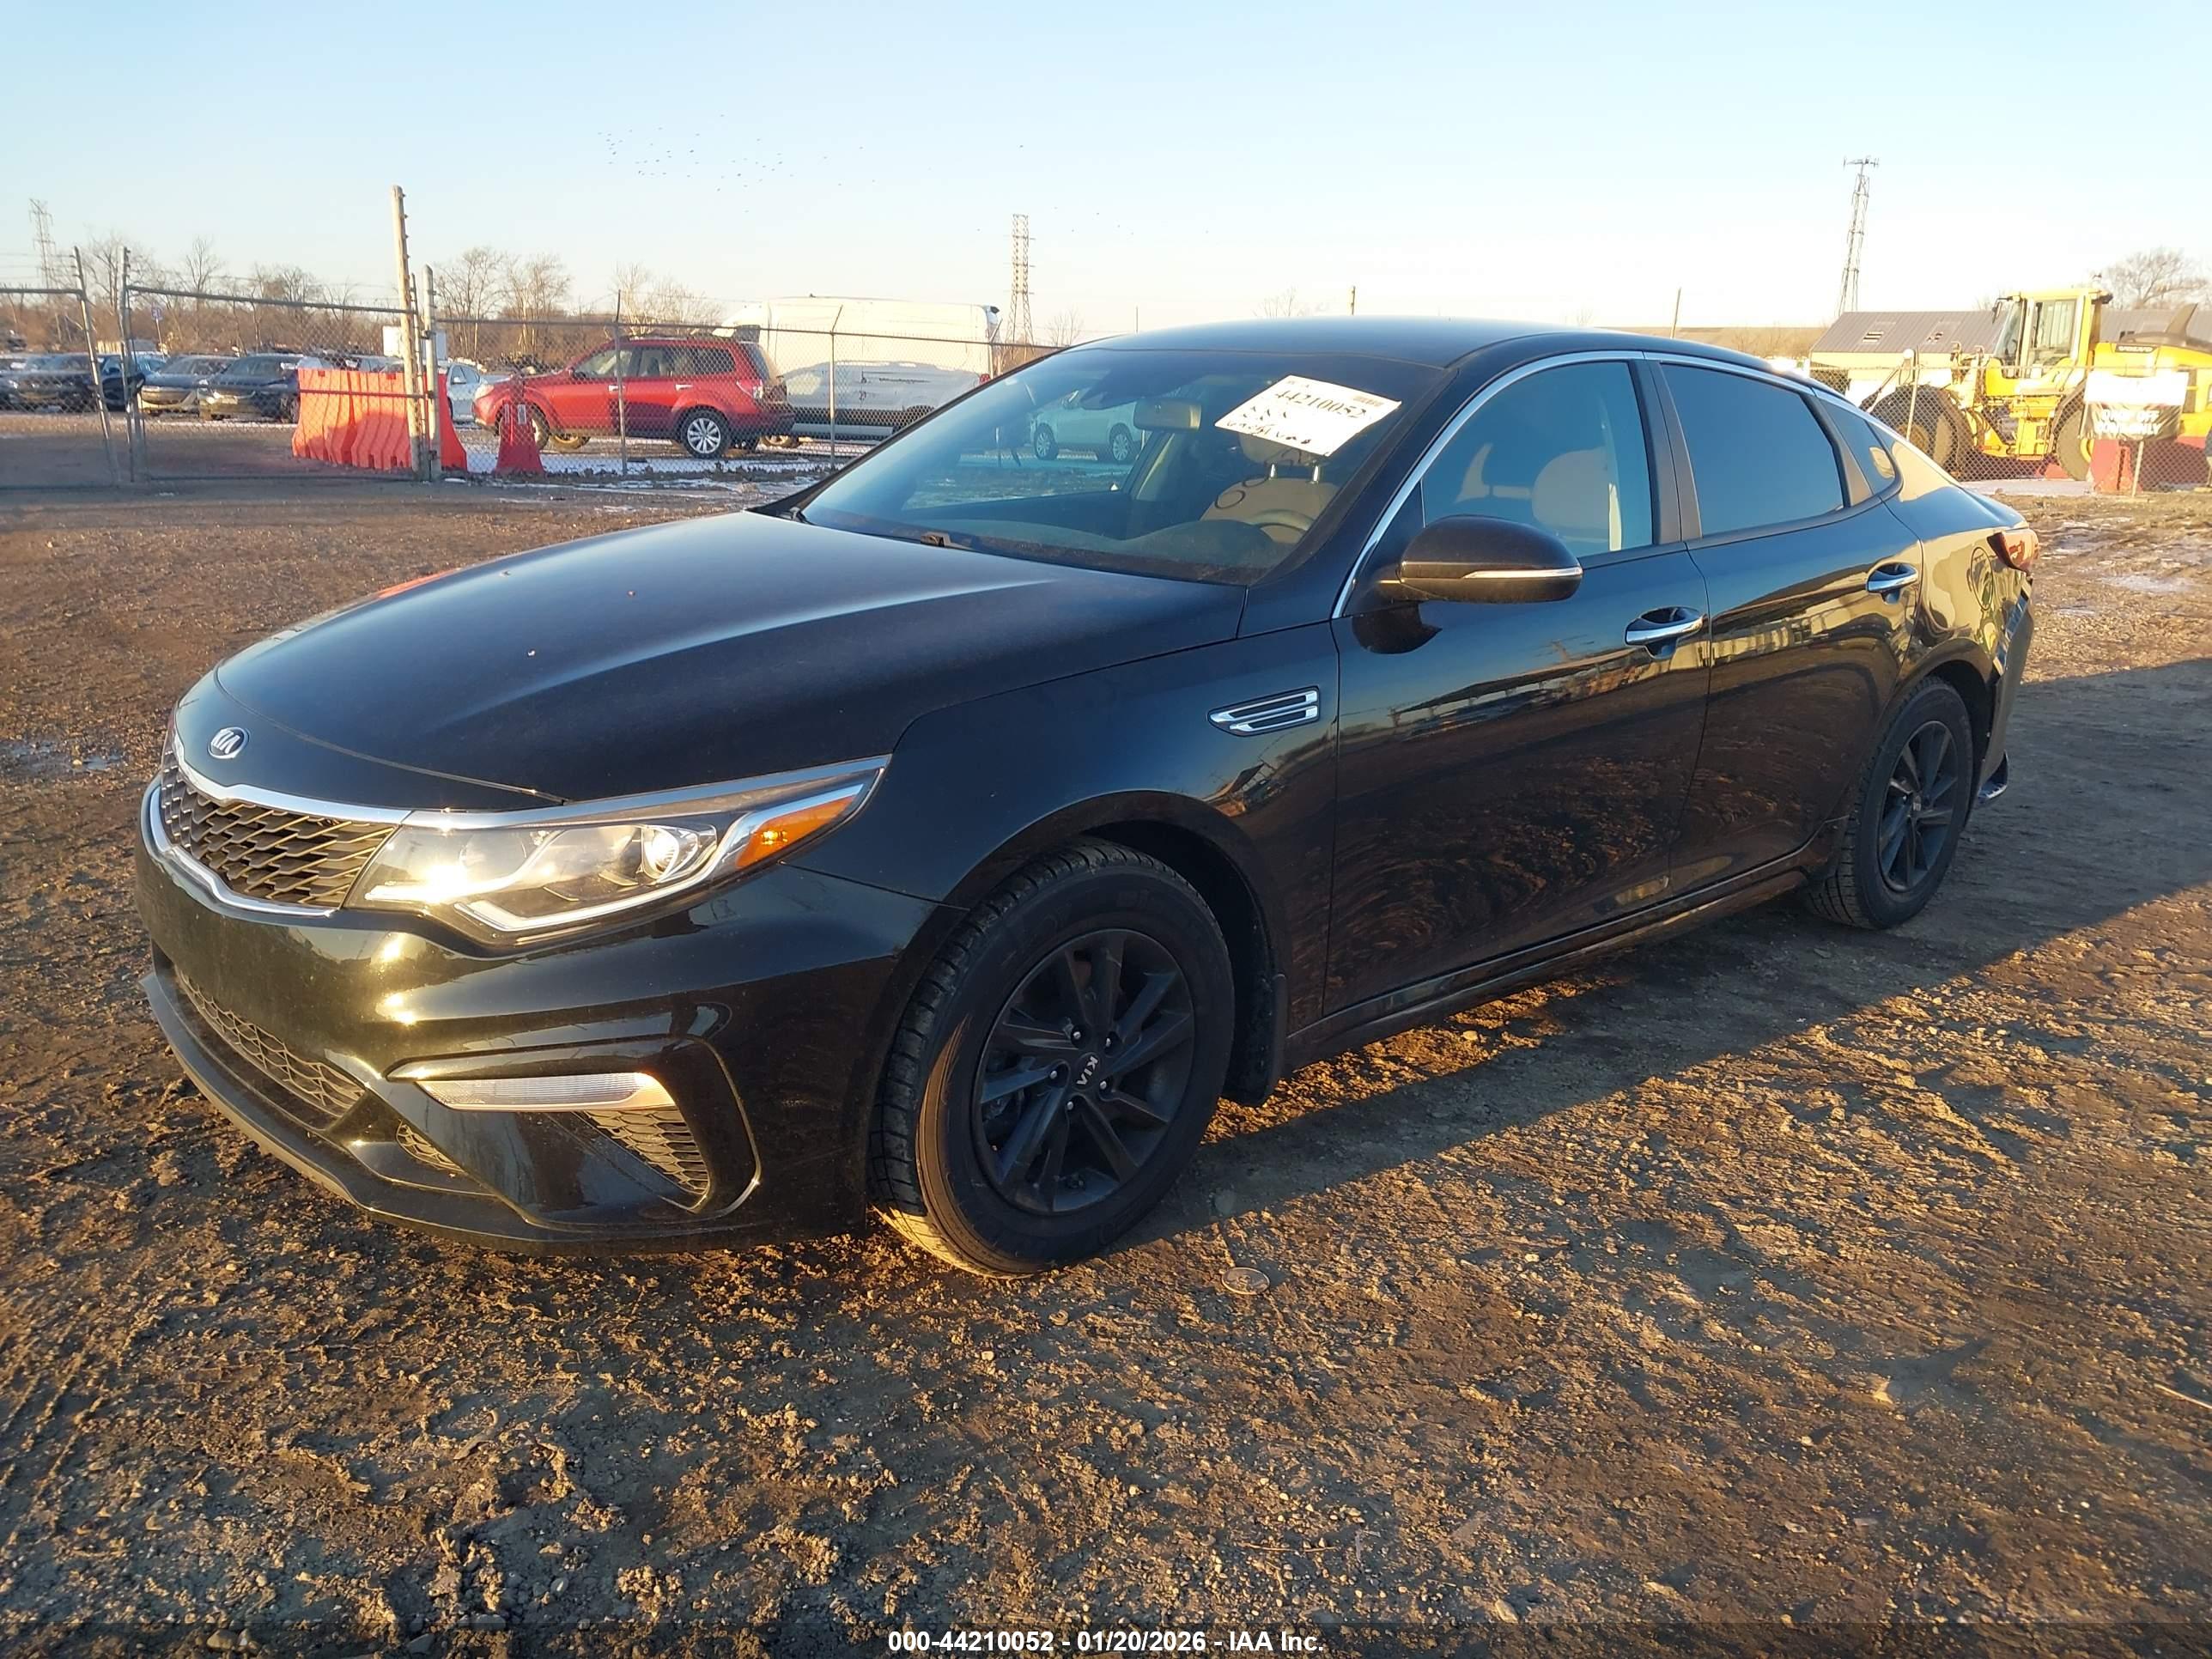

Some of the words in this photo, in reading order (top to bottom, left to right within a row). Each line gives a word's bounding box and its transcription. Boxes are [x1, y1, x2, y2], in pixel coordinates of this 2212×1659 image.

[1275, 389, 1368, 419] 44210052
[210, 728, 241, 755] KIA
[1076, 1055, 1098, 1085] KIA
